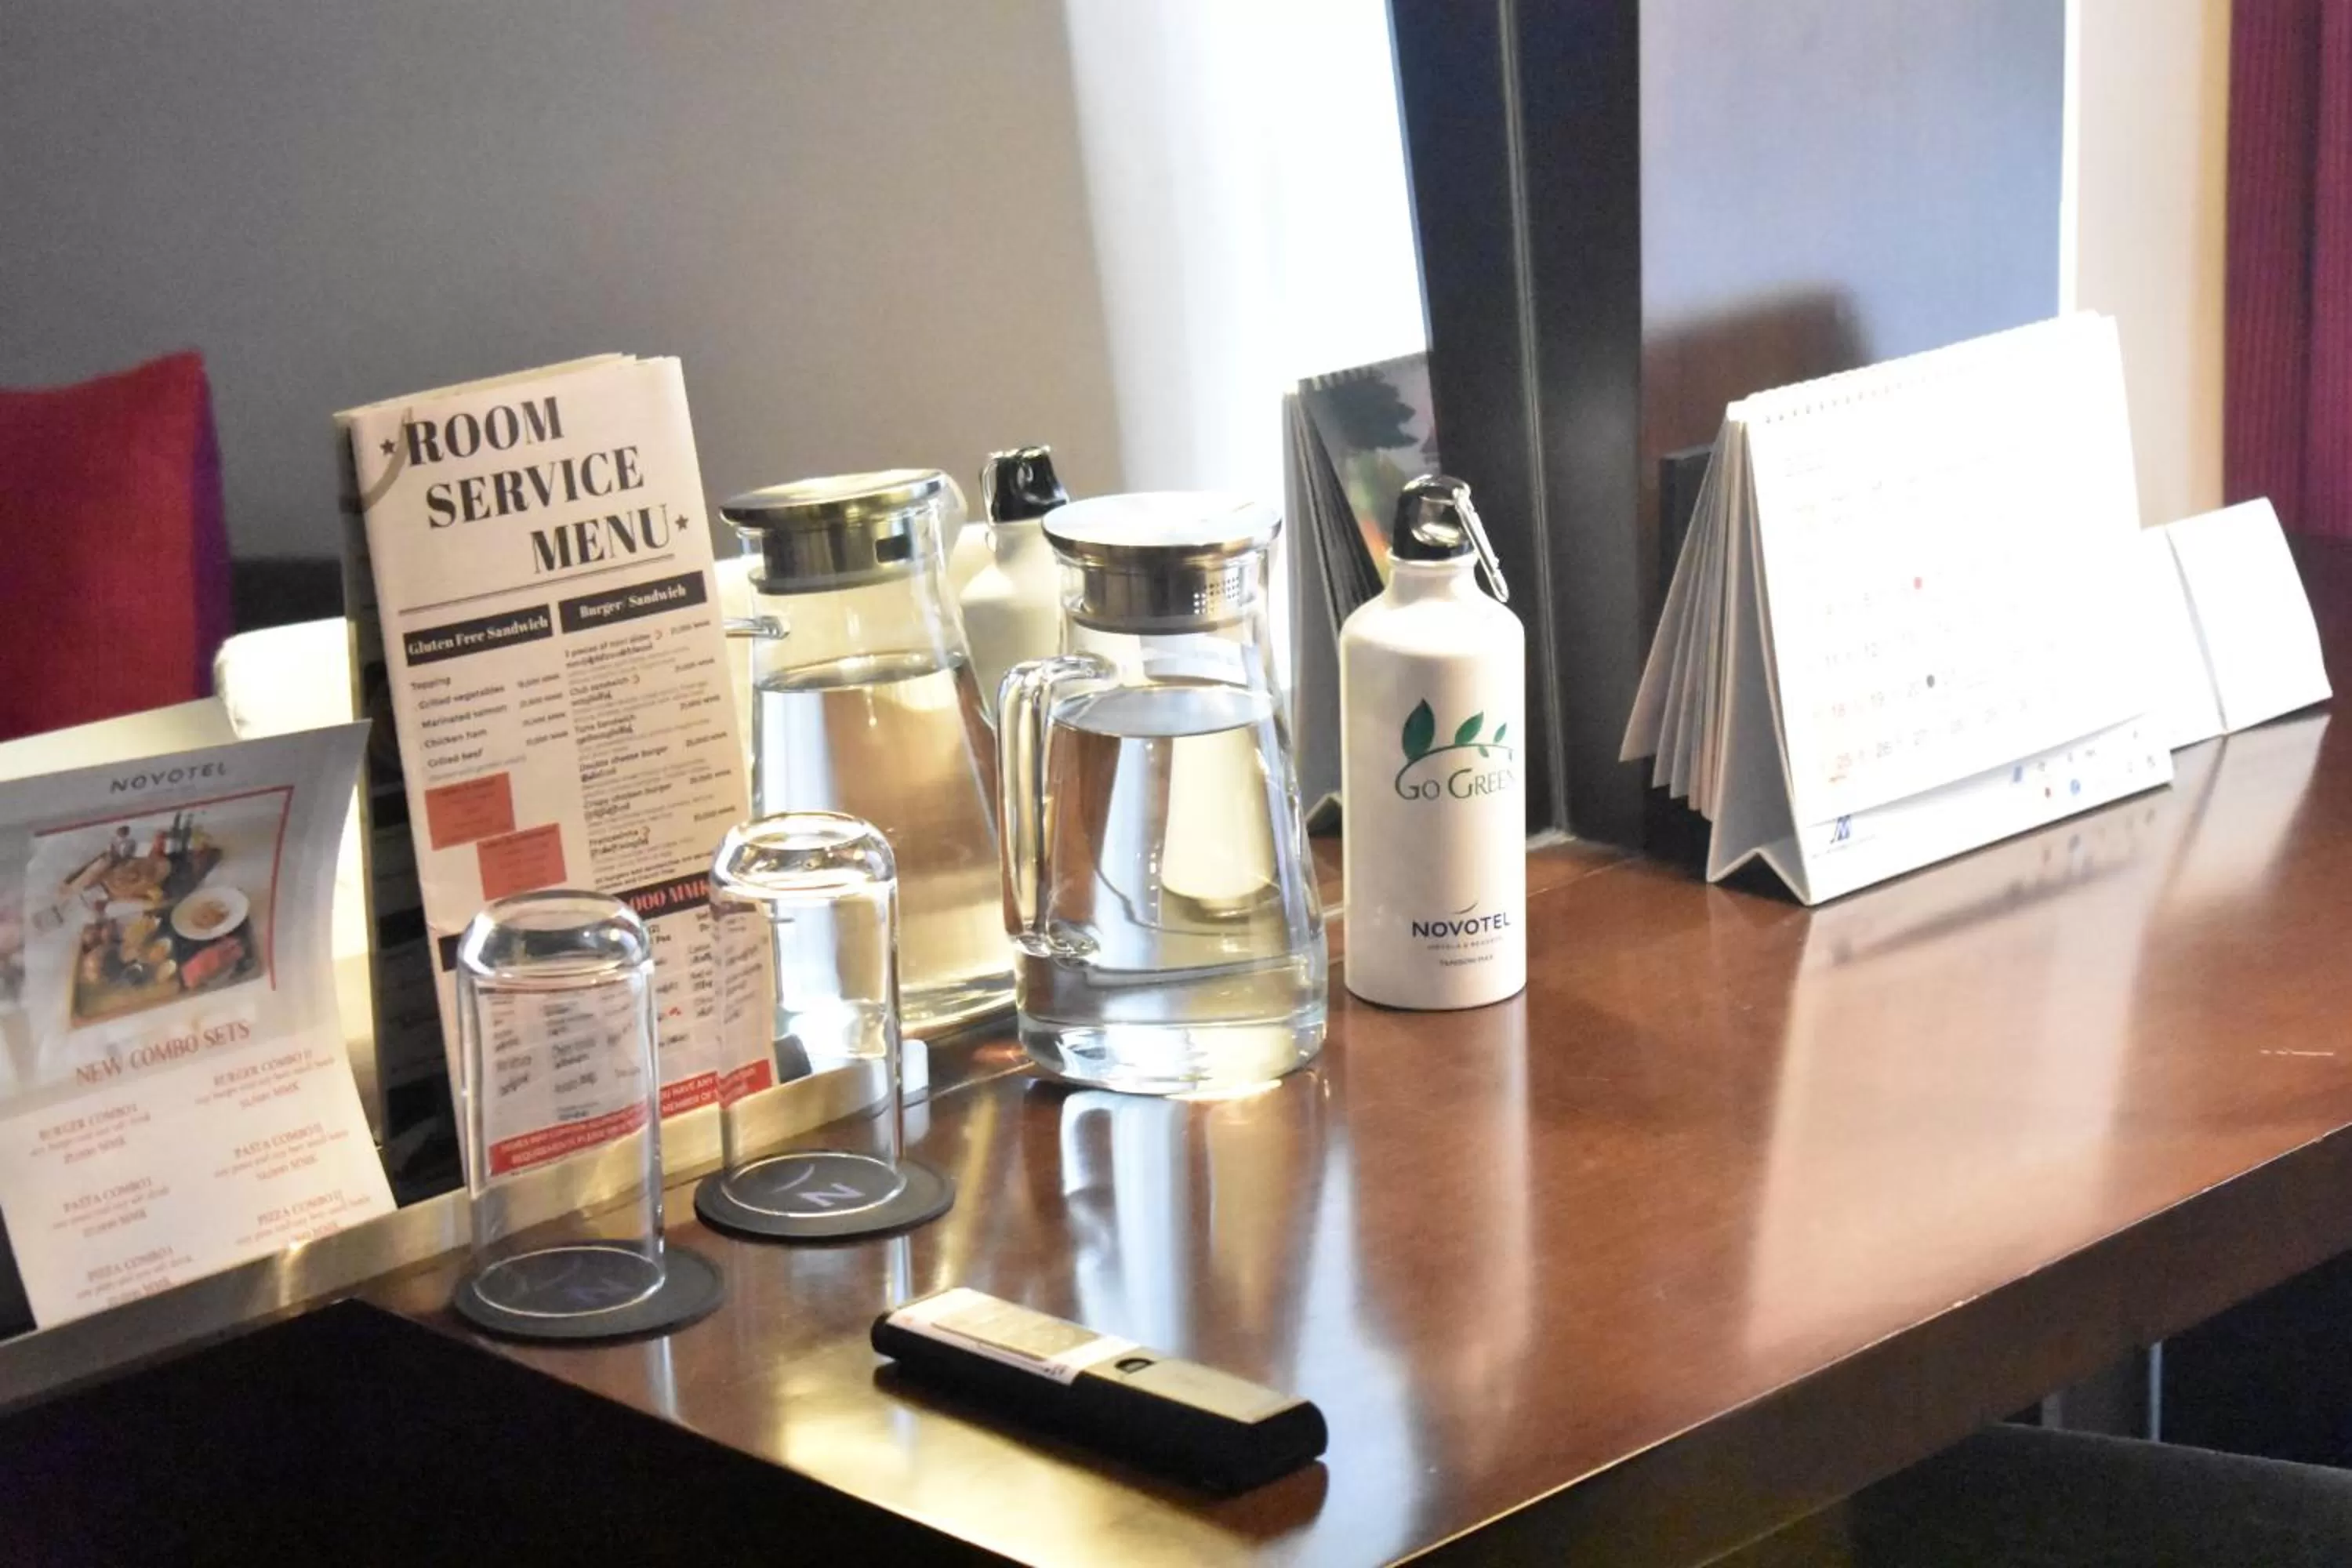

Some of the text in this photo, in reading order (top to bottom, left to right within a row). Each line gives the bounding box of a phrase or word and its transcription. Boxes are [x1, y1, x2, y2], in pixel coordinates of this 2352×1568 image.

[405, 396, 564, 467] ROOM
[426, 445, 645, 529] SERVICE
[530, 503, 672, 575] MENU
[629, 586, 687, 608] Sandwich
[408, 615, 549, 657] Gluten Free Sandwich
[109, 761, 227, 794] NOVOTEL
[1411, 912, 1512, 938] NOVOTEL
[76, 1020, 251, 1085] NEW COMBO SETS
